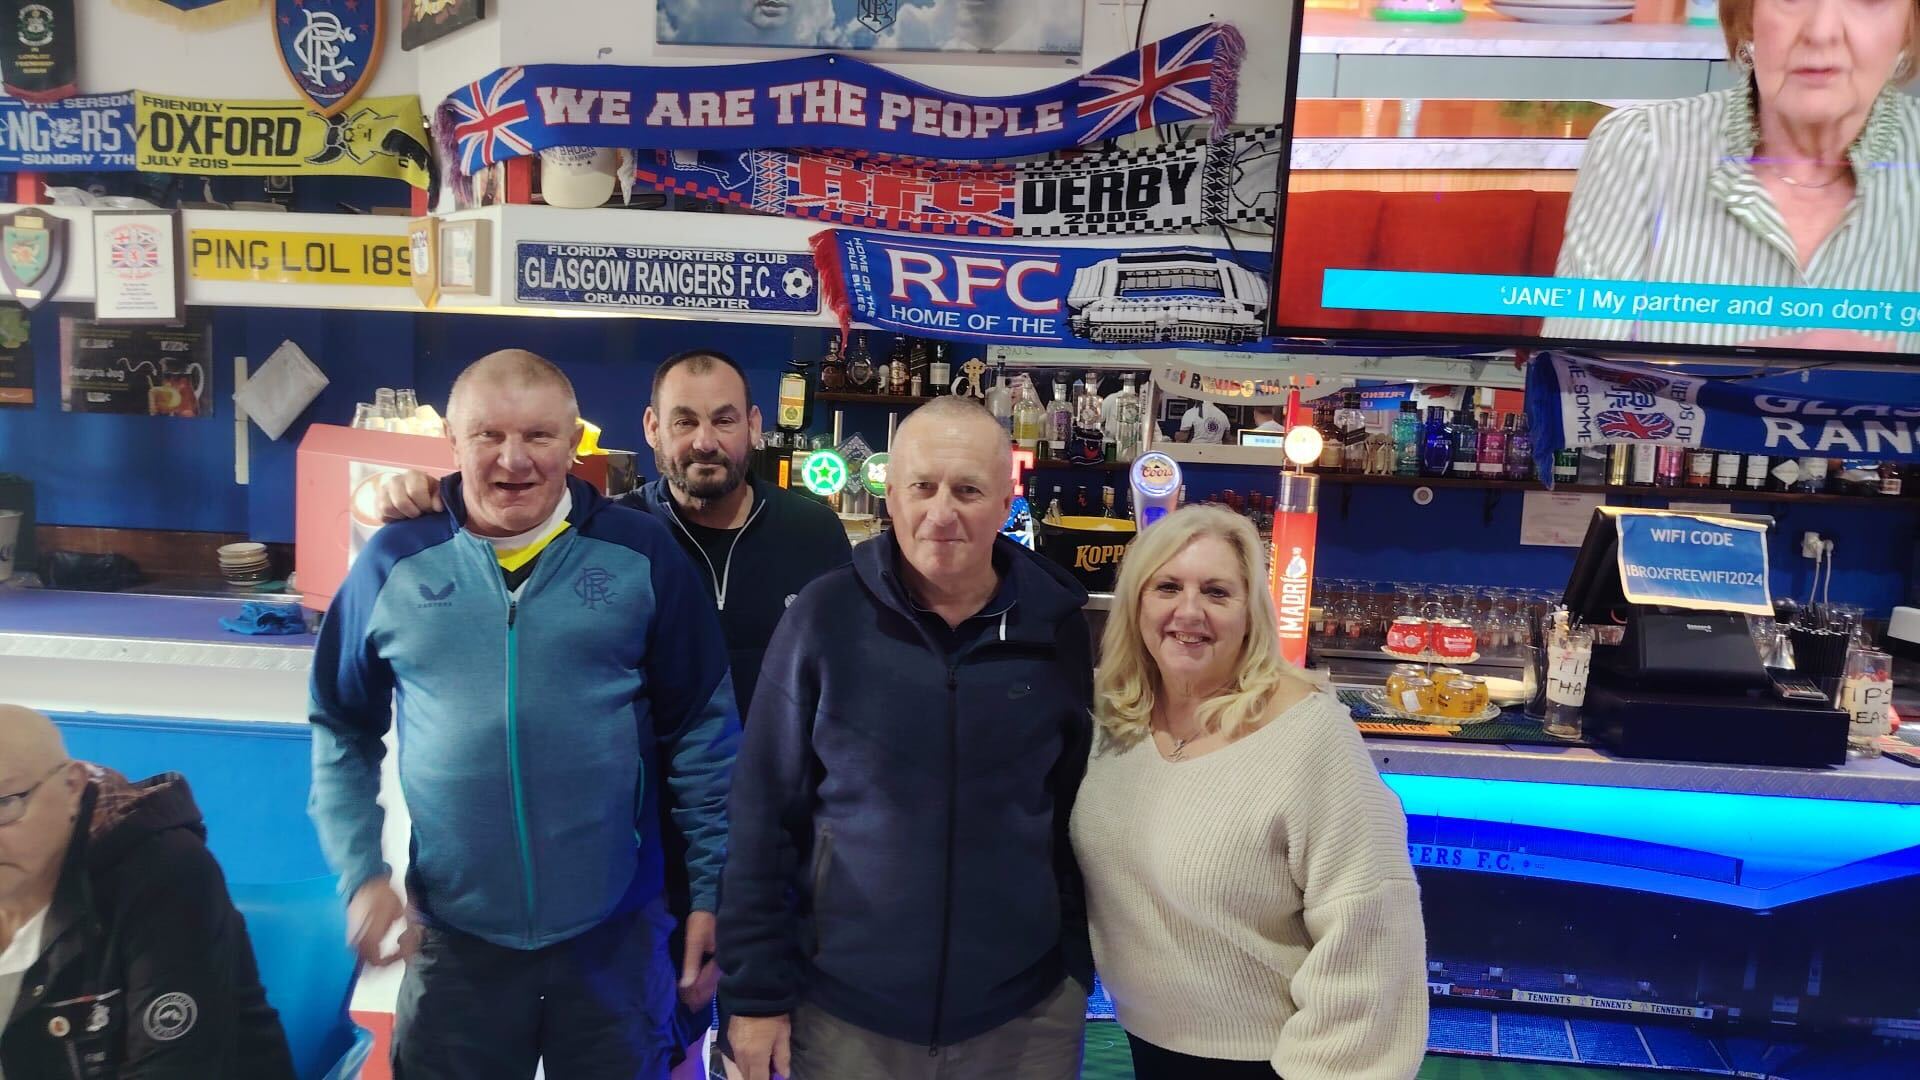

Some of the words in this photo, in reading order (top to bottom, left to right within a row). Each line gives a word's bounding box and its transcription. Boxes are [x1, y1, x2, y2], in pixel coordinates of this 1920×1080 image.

[142, 95, 224, 112] FRIENDLY
[536, 86, 632, 126] WE
[646, 88, 756, 127] ARE
[768, 79, 868, 127] THE
[878, 91, 1065, 139] PEOPLE
[150, 111, 302, 157] OXFORD
[21, 153, 94, 165] SUNDAY
[99, 153, 135, 165] 7TH
[141, 154, 182, 167] JULY
[188, 157, 229, 169] 2019
[1022, 161, 1199, 215] DERBY
[898, 210, 972, 225] MAY
[1063, 209, 1149, 225] 2006
[191, 238, 270, 270] PING
[281, 241, 351, 274] LOL
[547, 245, 619, 258] FLORIDA
[625, 248, 736, 263] SUPPORTERS
[743, 252, 789, 265] CLUB
[523, 256, 631, 292] GLASGOW
[634, 261, 736, 297] RANGERS
[740, 265, 777, 299] F.C.
[884, 248, 1062, 314] RFC
[583, 292, 665, 307] ORLANDO
[672, 296, 751, 310] CHAPTER
[1592, 289, 1626, 315] My
[1631, 293, 1721, 316] partner
[1726, 296, 1774, 317] and
[1779, 301, 1824, 318] son
[1831, 299, 1893, 321] don’t
[890, 304, 961, 328] HOME
[966, 313, 1001, 332] OF
[1006, 316, 1057, 335] THE
[1573, 384, 1594, 444] SOMME
[1760, 415, 1920, 455] RAN
[1141, 463, 1174, 478] Coors
[1650, 527, 1686, 544] WIFI
[1690, 530, 1735, 547] CODE
[1625, 563, 1764, 587] IBROXFREEWIFI2024
[1549, 677, 1586, 696] THA
[1476, 851, 1515, 872] F.C.
